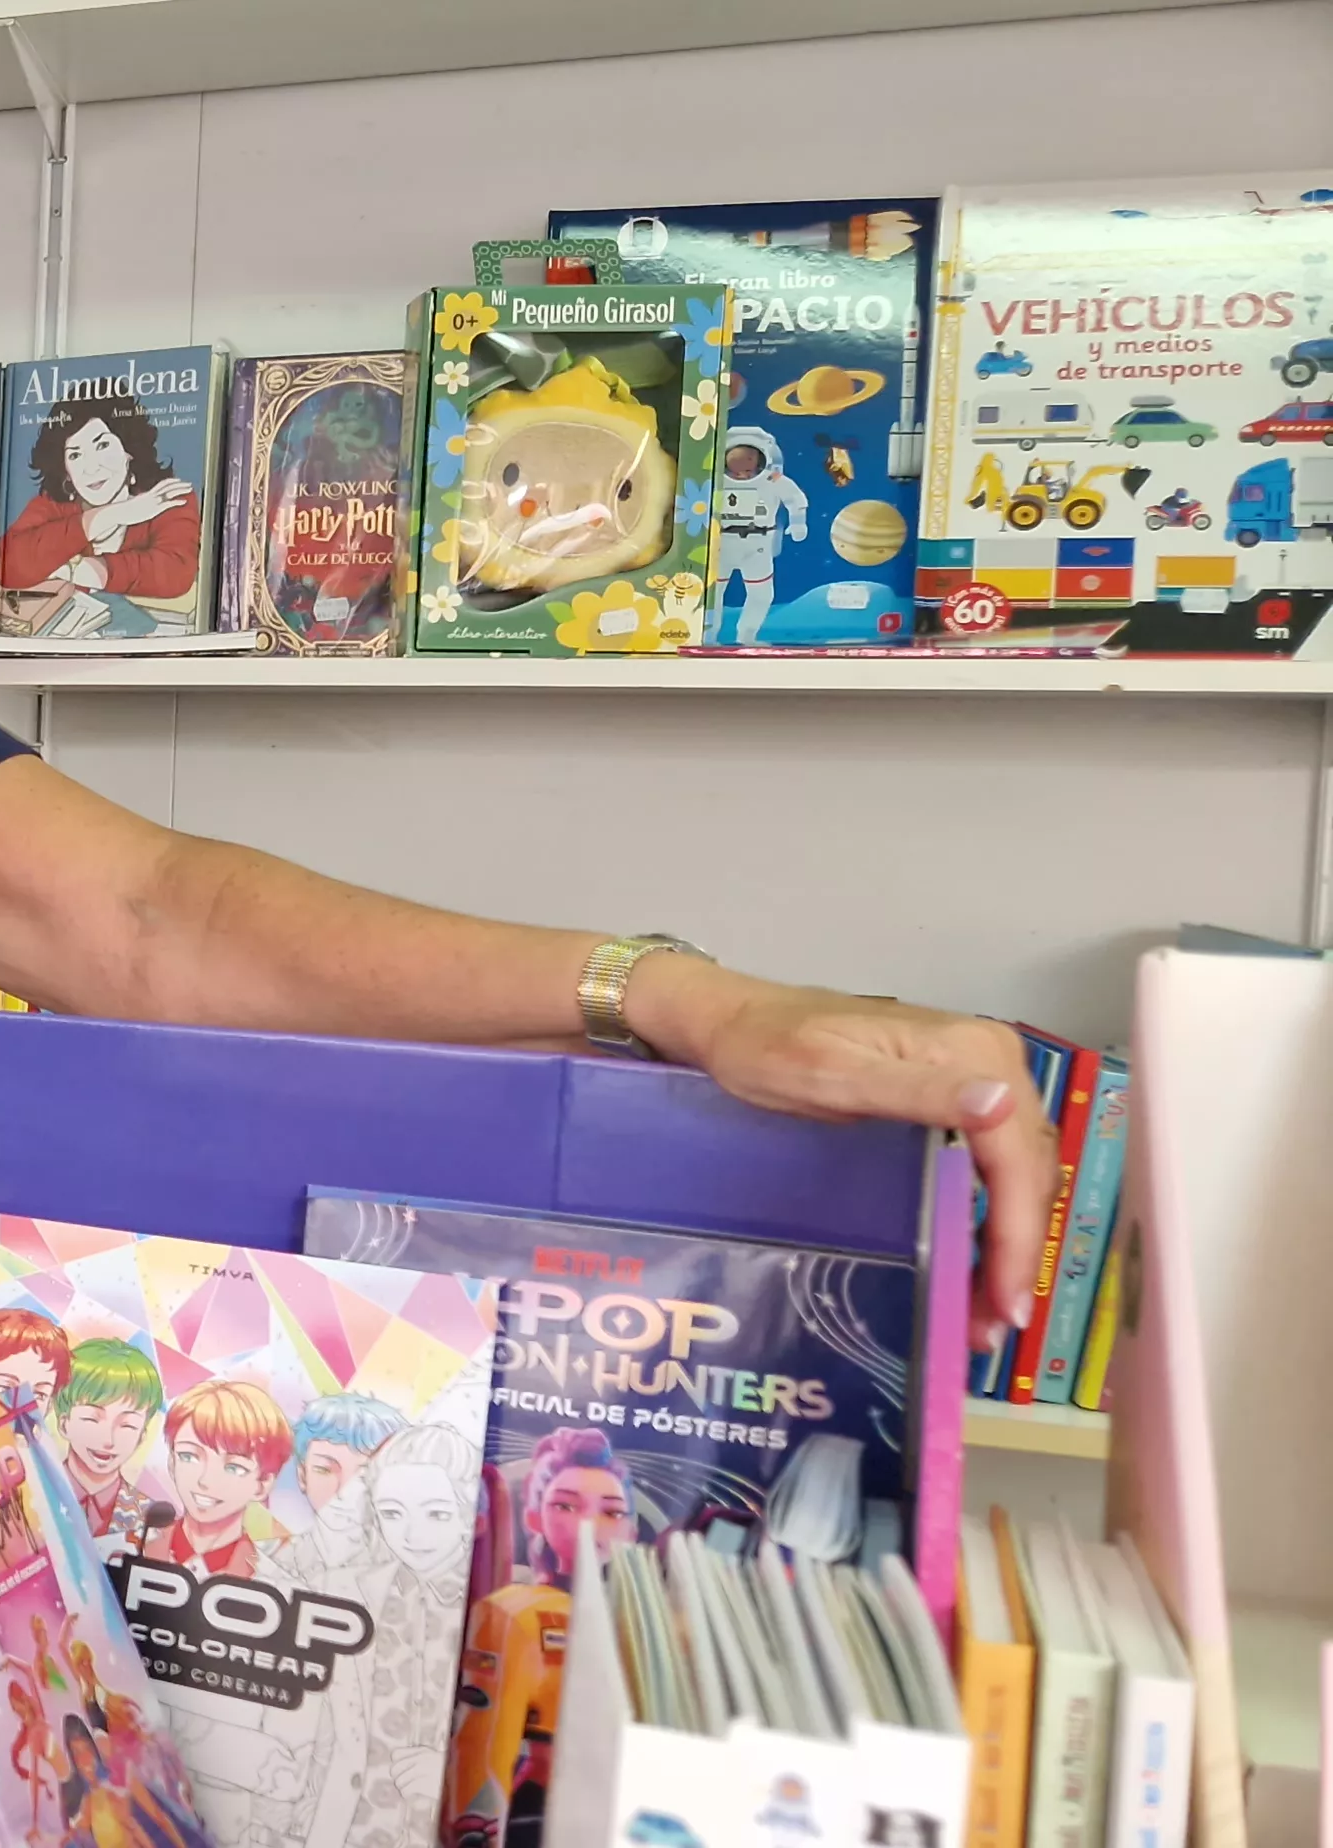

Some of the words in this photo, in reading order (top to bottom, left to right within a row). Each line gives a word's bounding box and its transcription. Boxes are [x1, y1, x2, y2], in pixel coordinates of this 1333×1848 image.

[779, 269, 836, 290] libro
[492, 290, 507, 307] Mi
[512, 298, 599, 329] Pequeño
[604, 297, 675, 324] Girasol
[980, 287, 1296, 336] VEHÍCULOS
[453, 313, 479, 330] 0+
[1089, 340, 1102, 362] y
[1114, 335, 1213, 354] medios
[20, 359, 200, 406] Almudena
[1057, 361, 1086, 381] de
[1098, 359, 1243, 384] transporte
[274, 504, 344, 548] Harry
[287, 552, 328, 565] CÁLIZ
[331, 552, 349, 565] DE
[953, 598, 996, 625] 60
[1254, 625, 1290, 642] sm
[188, 1263, 254, 1283] TIMVA
[593, 1352, 834, 1421] HUNTERS
[587, 1401, 626, 1428] DE
[633, 1402, 789, 1450] PÓSTERES
[123, 1570, 371, 1650] POP
[131, 1624, 327, 1681] COLOREAR
[190, 1666, 292, 1706] COREANA
